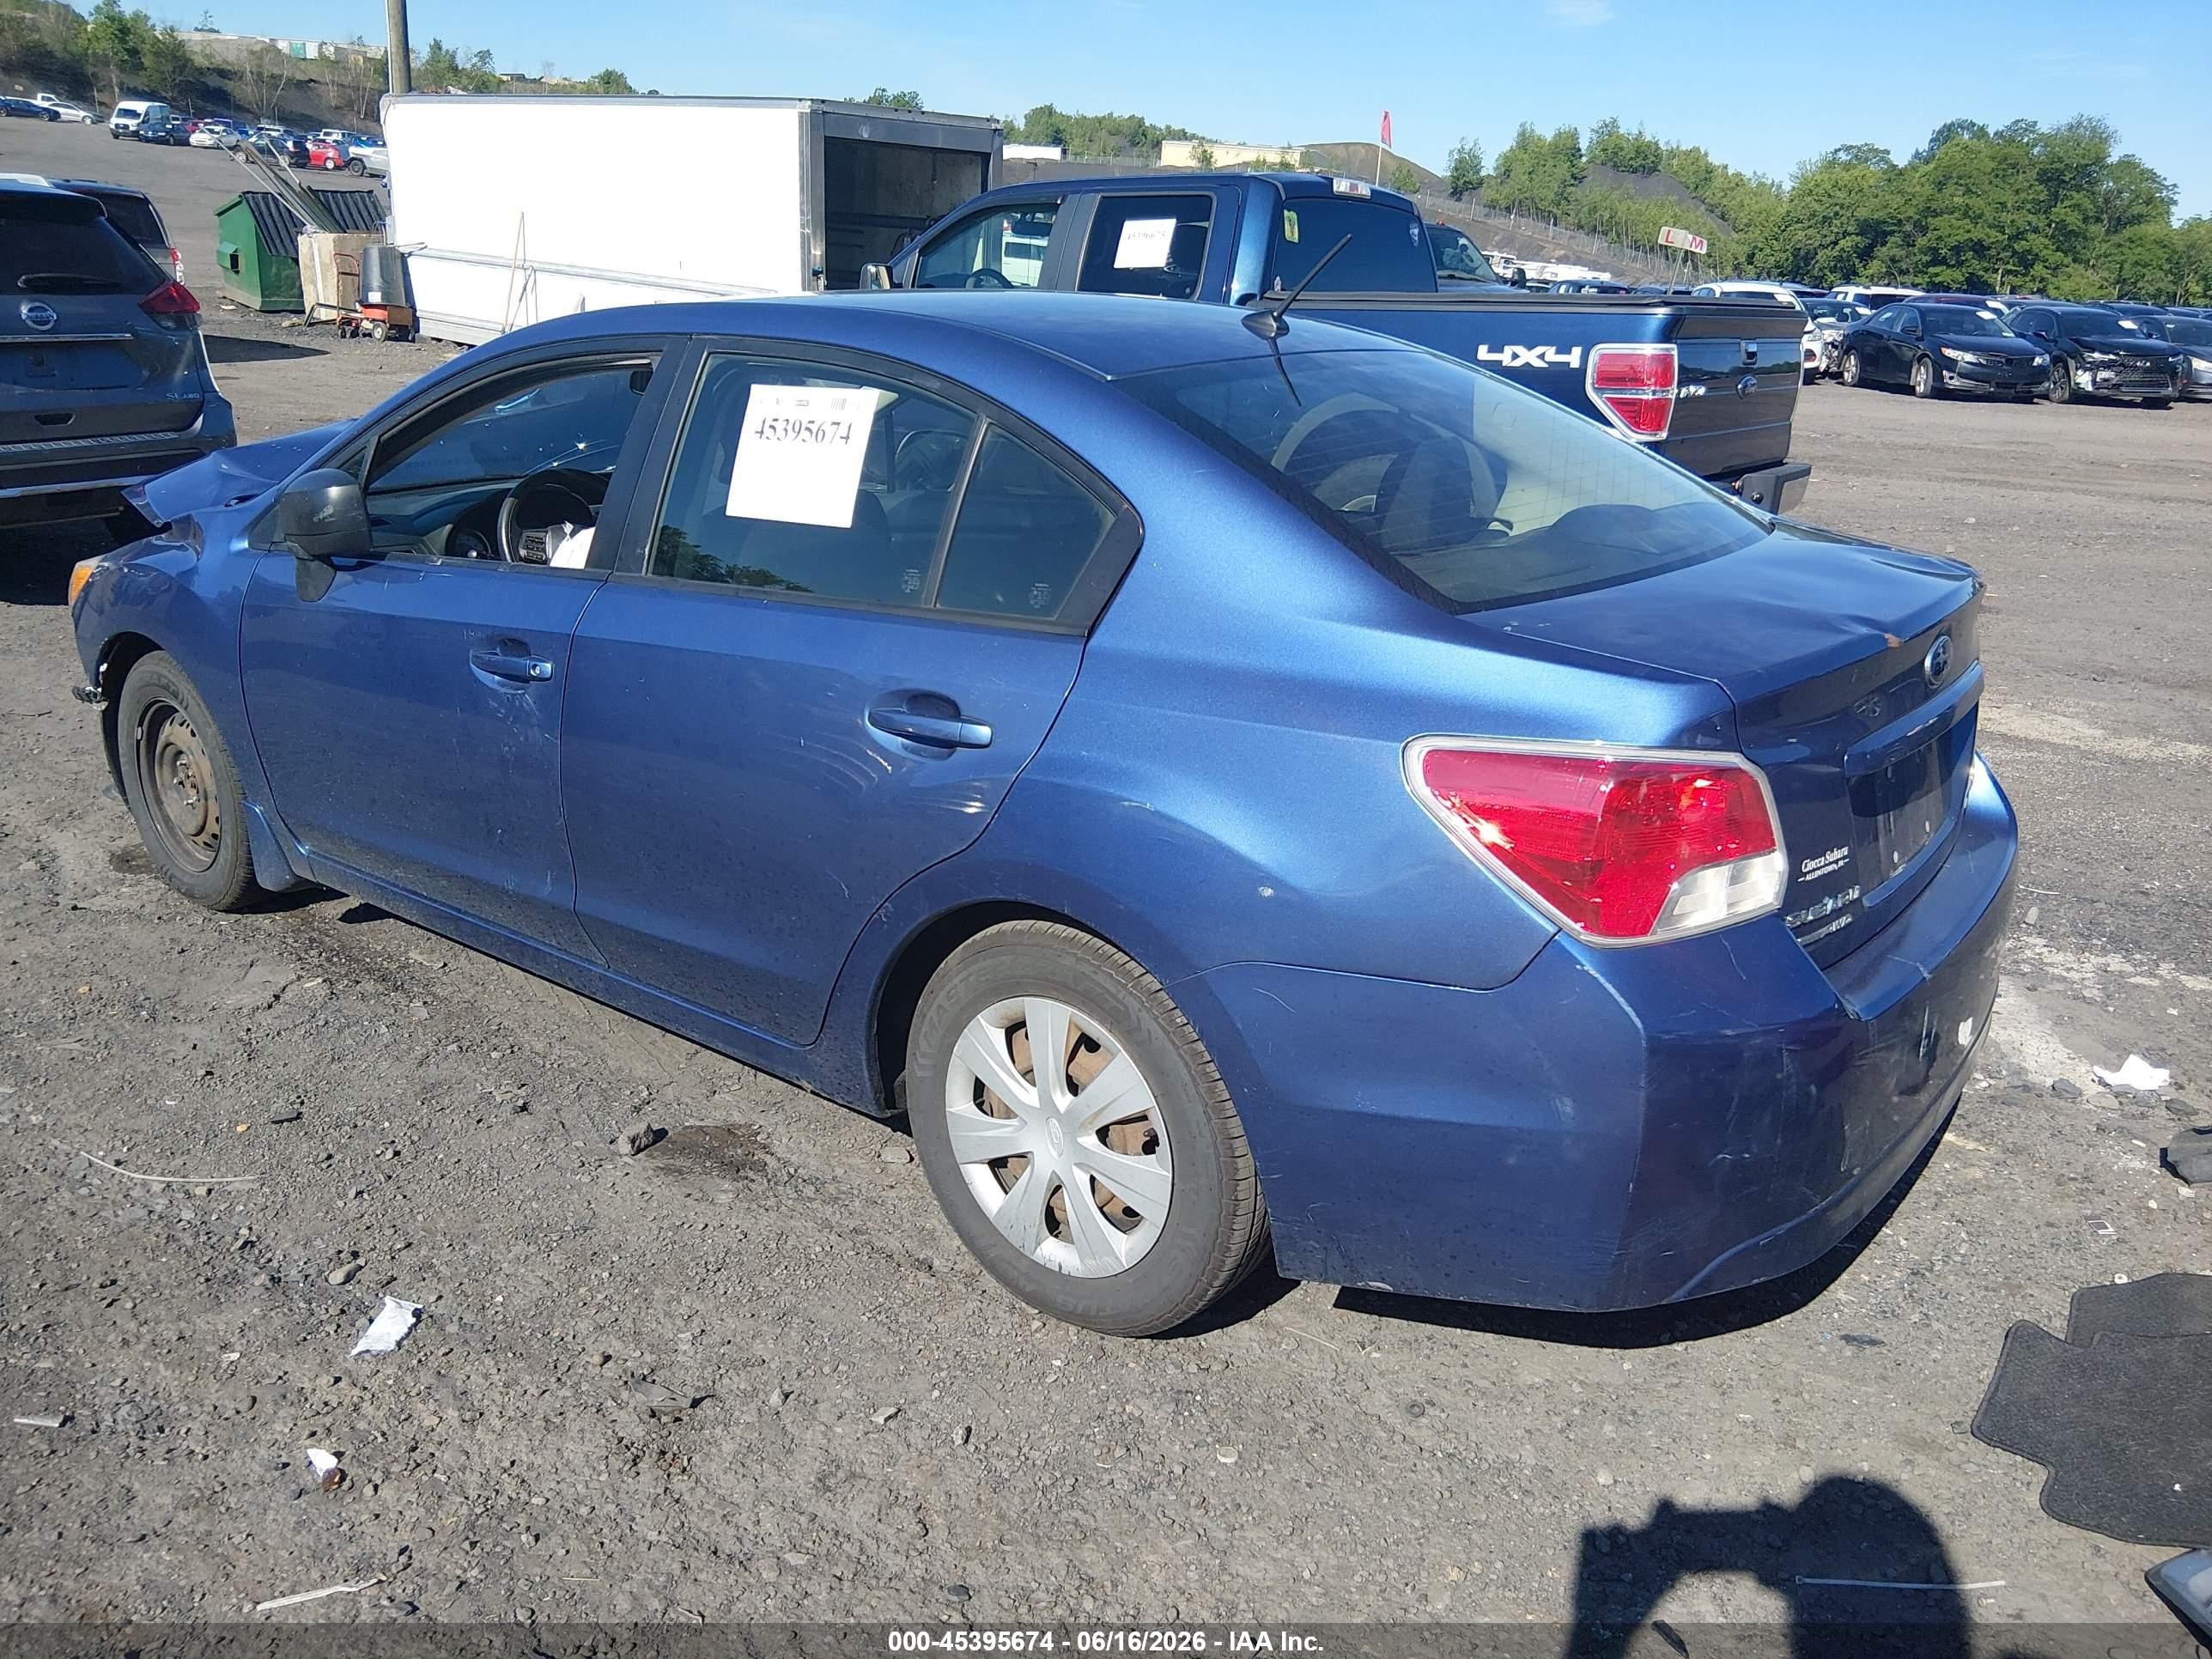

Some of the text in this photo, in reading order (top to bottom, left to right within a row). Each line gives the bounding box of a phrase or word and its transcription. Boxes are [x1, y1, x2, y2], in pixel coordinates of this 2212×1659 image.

[1665, 229, 1674, 244] L
[1690, 236, 1704, 251] M
[1477, 344, 1582, 368] 4X4
[755, 417, 853, 445] 45395674
[1802, 847, 1849, 872] Ciocca Subaru
